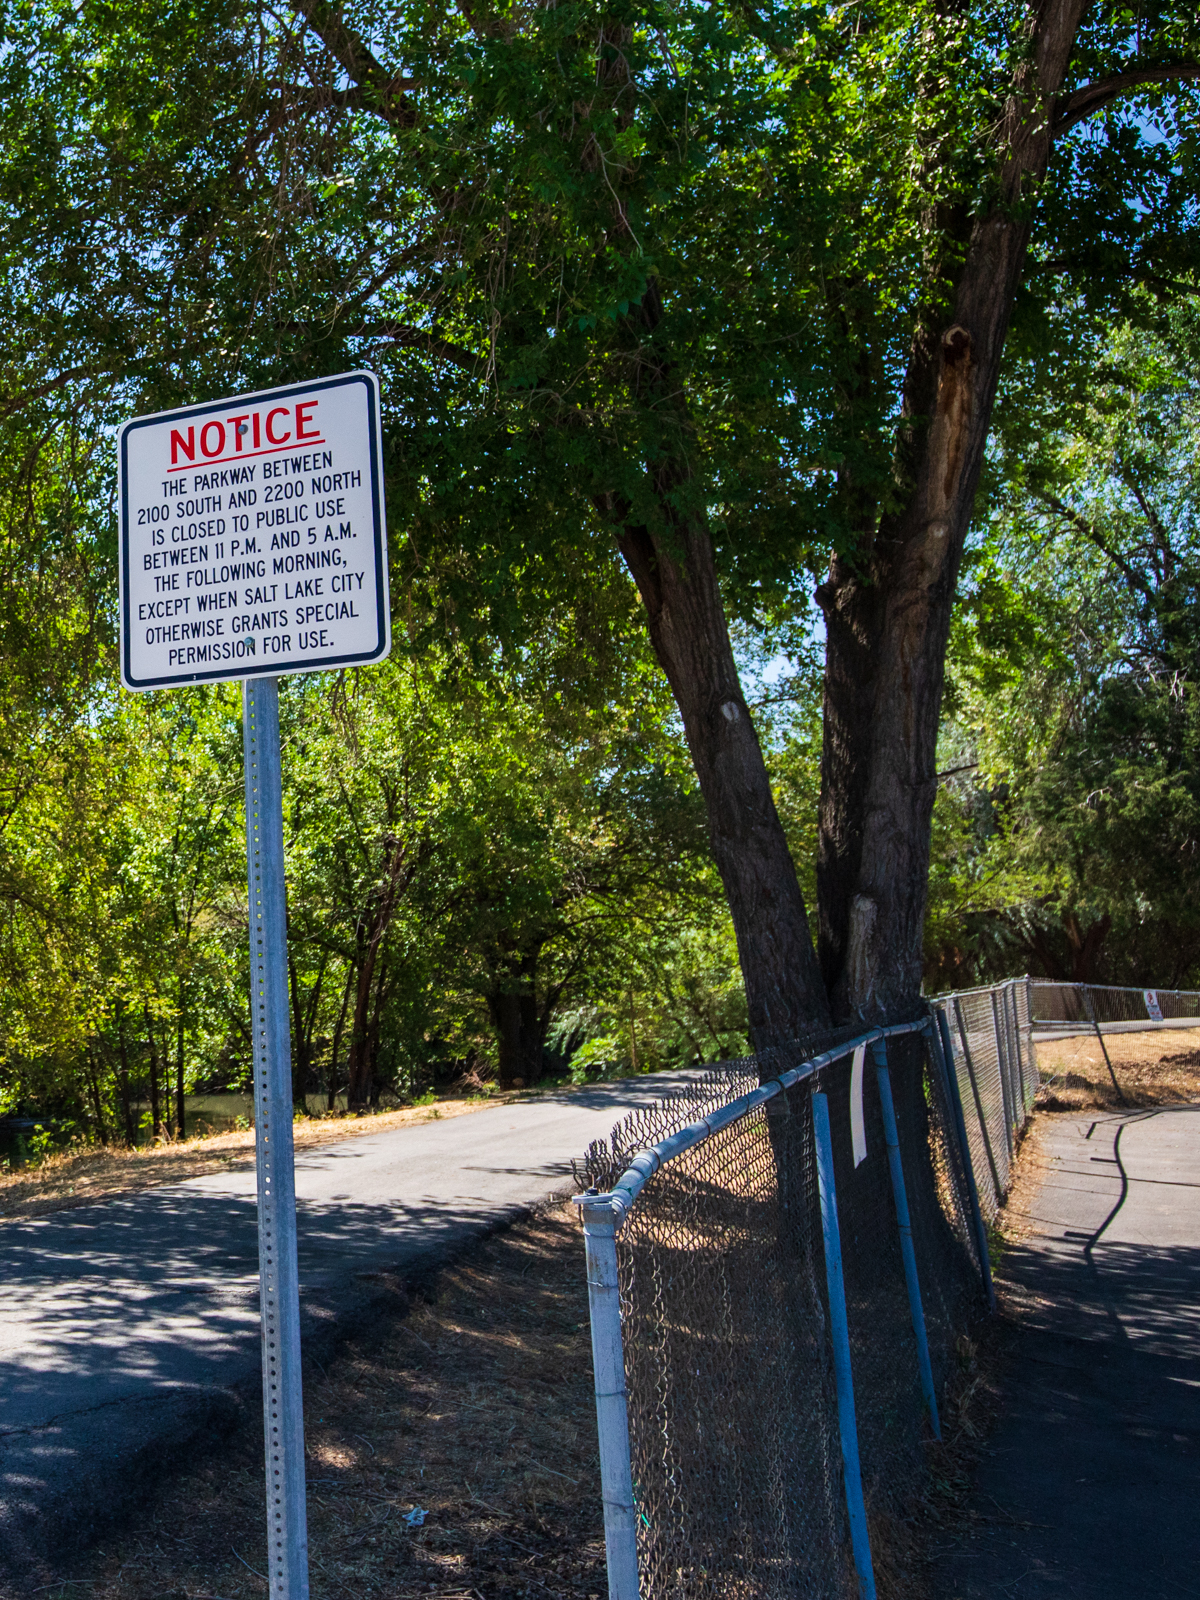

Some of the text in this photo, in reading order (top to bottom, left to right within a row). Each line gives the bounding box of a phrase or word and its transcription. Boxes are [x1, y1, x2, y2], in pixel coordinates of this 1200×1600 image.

[170, 400, 321, 465] NOTICE
[137, 469, 361, 526] 2100 SOUTH AND 2200 NORTH
[161, 450, 333, 498] THE PARKWAY BETWEEN
[143, 521, 357, 571] BETWEEN 11 P.M. AND 5 A.M.
[152, 497, 346, 547] IS CLOSED TO PUBLIC USE
[153, 548, 347, 593] THE FOLLOWING MORNING,
[138, 571, 365, 621] EXCEPT WHEN SALT LAKE CITY
[145, 600, 360, 645] OTHERWISE GRANTS SPECIAL
[169, 629, 334, 666] PERMISSION FOR USE.
